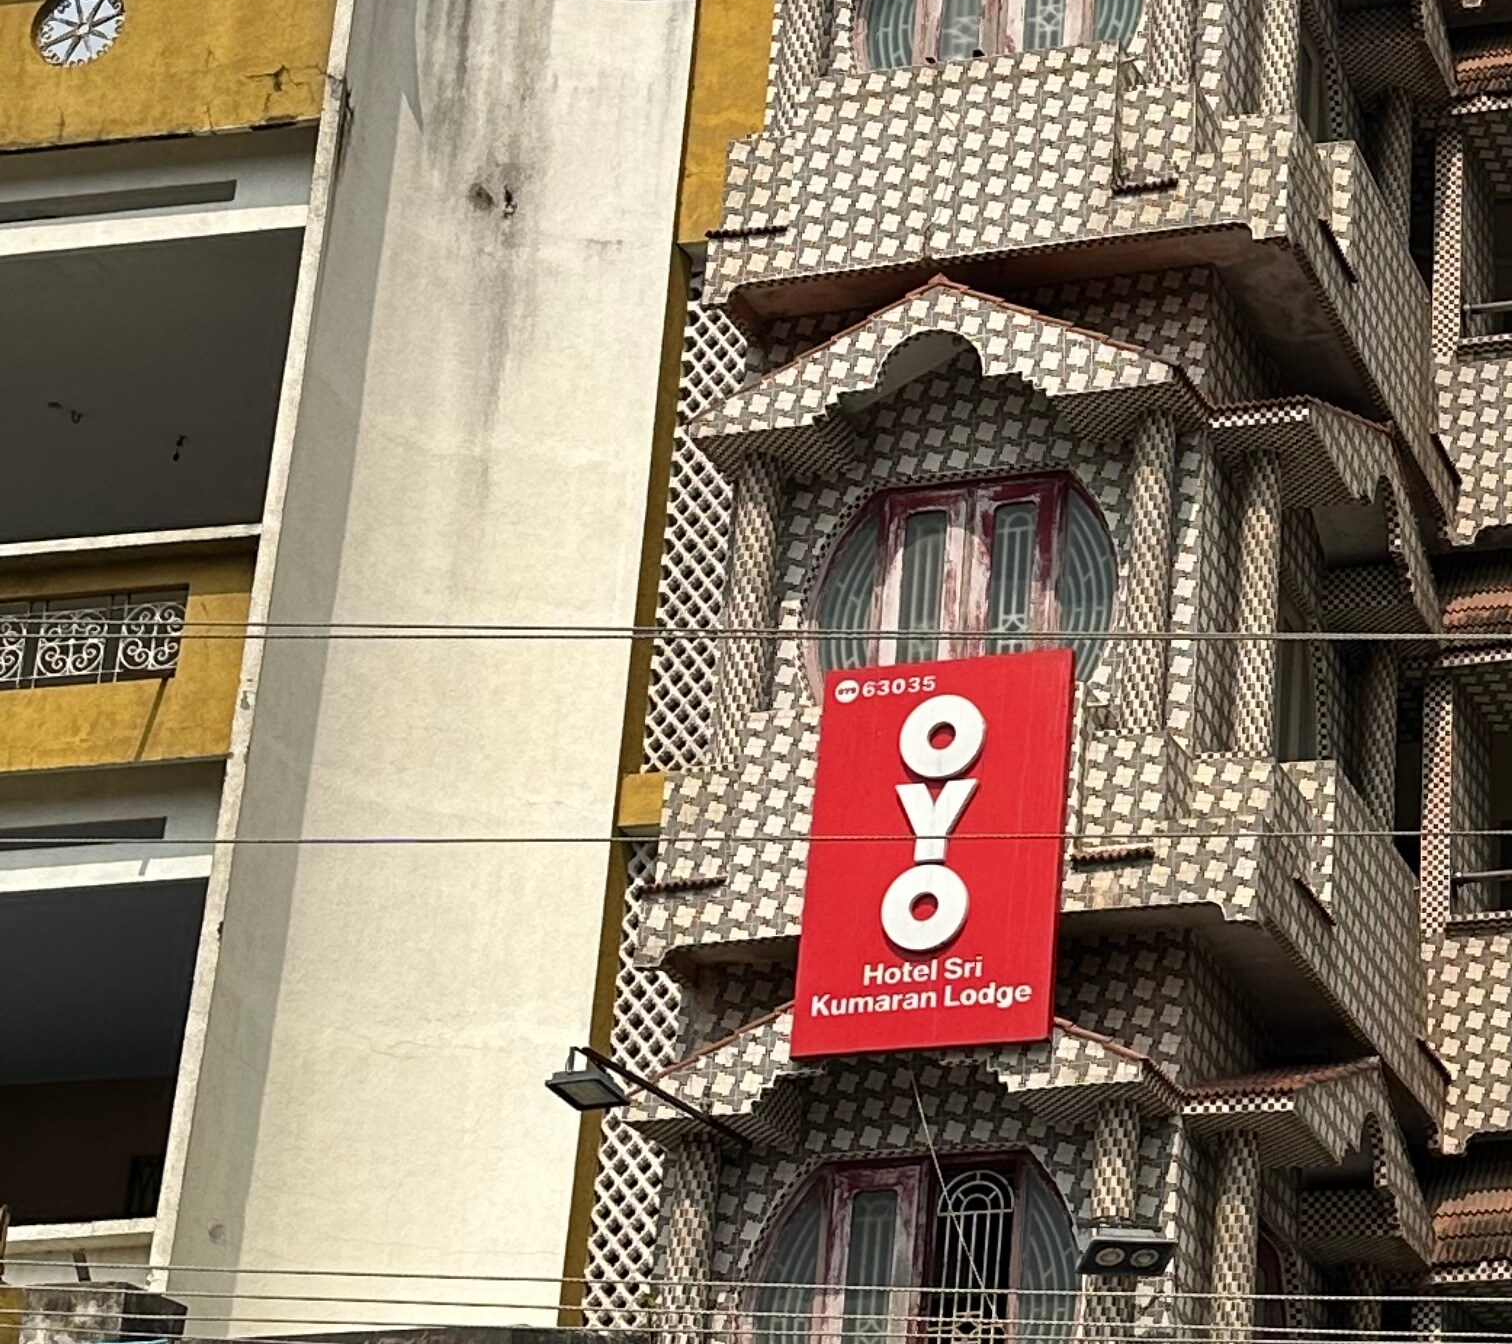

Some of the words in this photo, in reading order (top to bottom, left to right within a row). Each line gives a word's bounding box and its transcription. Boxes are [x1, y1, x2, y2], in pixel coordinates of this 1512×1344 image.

[862, 675, 937, 698] 63035
[881, 694, 987, 951] OYO
[863, 958, 937, 986] Hotel
[944, 956, 984, 980] Sri
[811, 987, 937, 1017] Kumaran
[944, 983, 1033, 1010] Lodge
